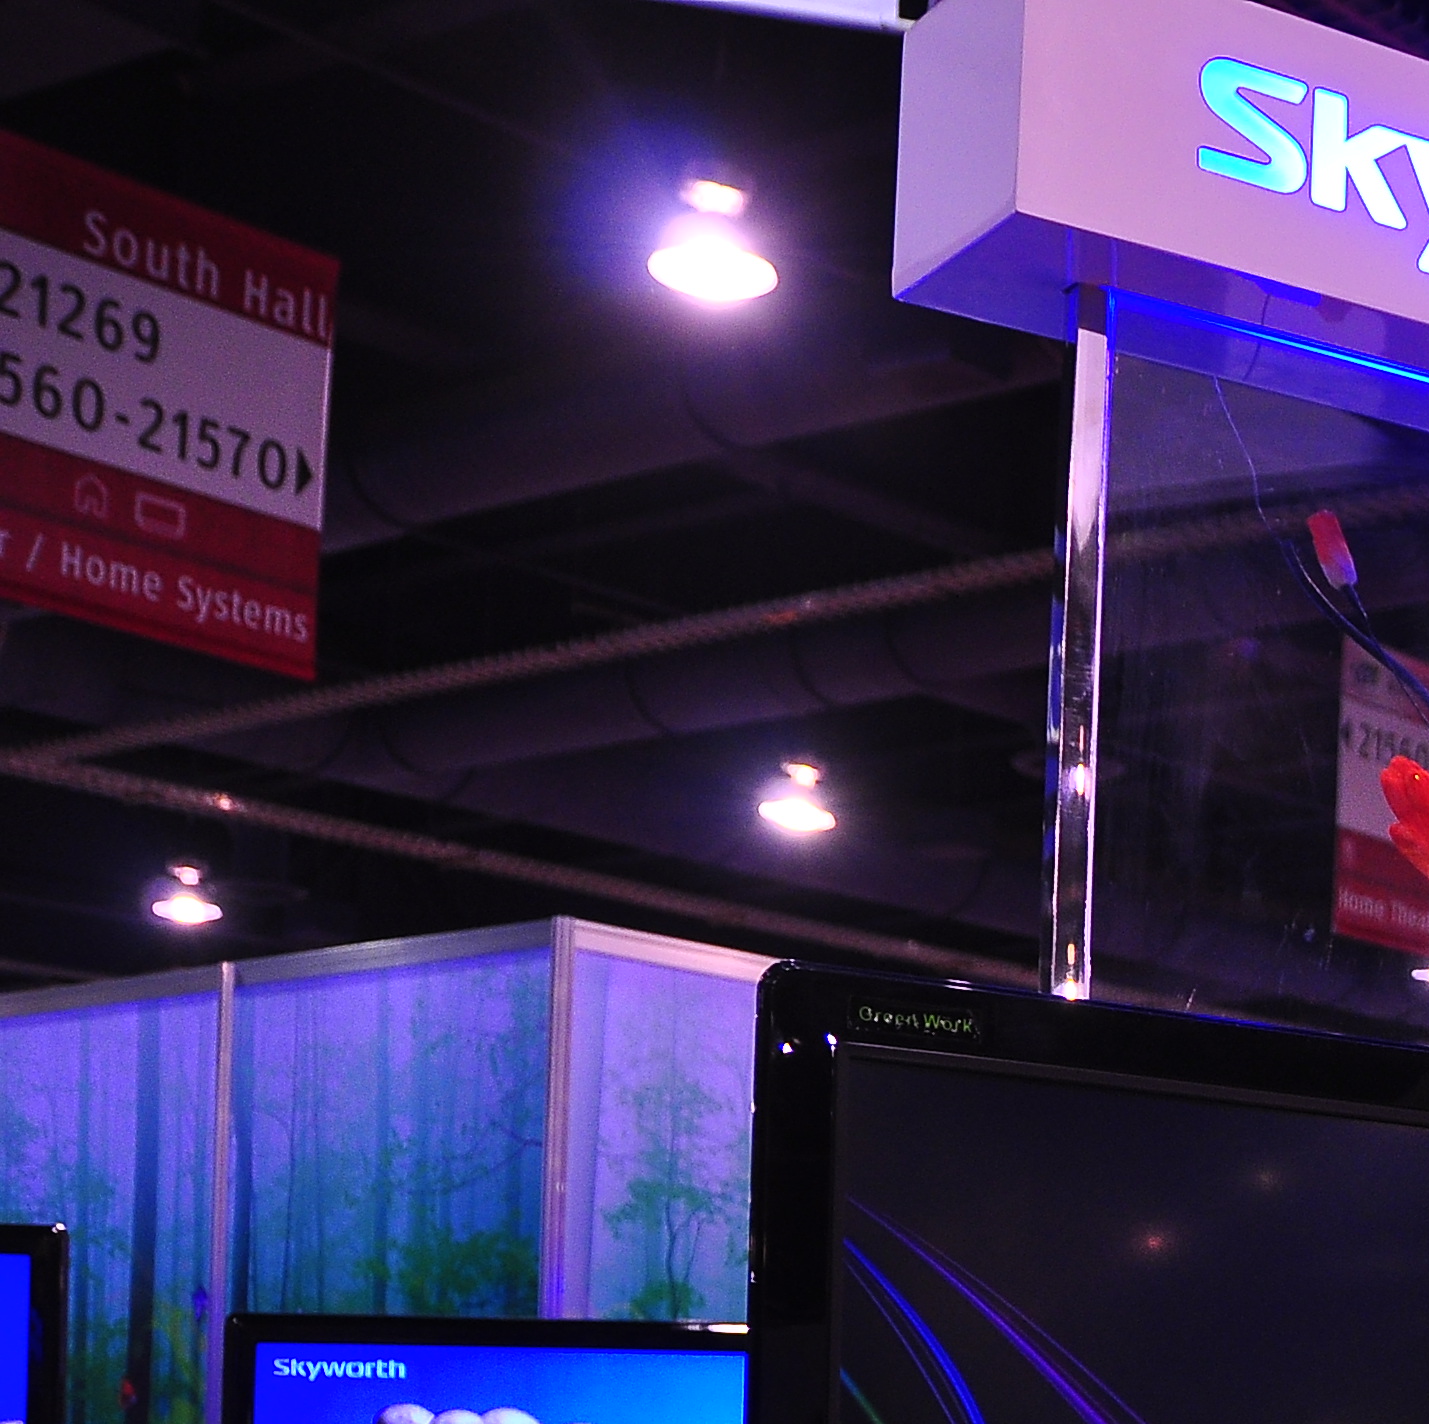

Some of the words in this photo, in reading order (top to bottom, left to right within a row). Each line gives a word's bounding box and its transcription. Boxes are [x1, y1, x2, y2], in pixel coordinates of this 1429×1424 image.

[83, 210, 220, 298] South
[243, 268, 331, 341] Hall
[60, 541, 164, 602] Home
[176, 574, 310, 643] Systems
[273, 1356, 407, 1381] Skyworth
